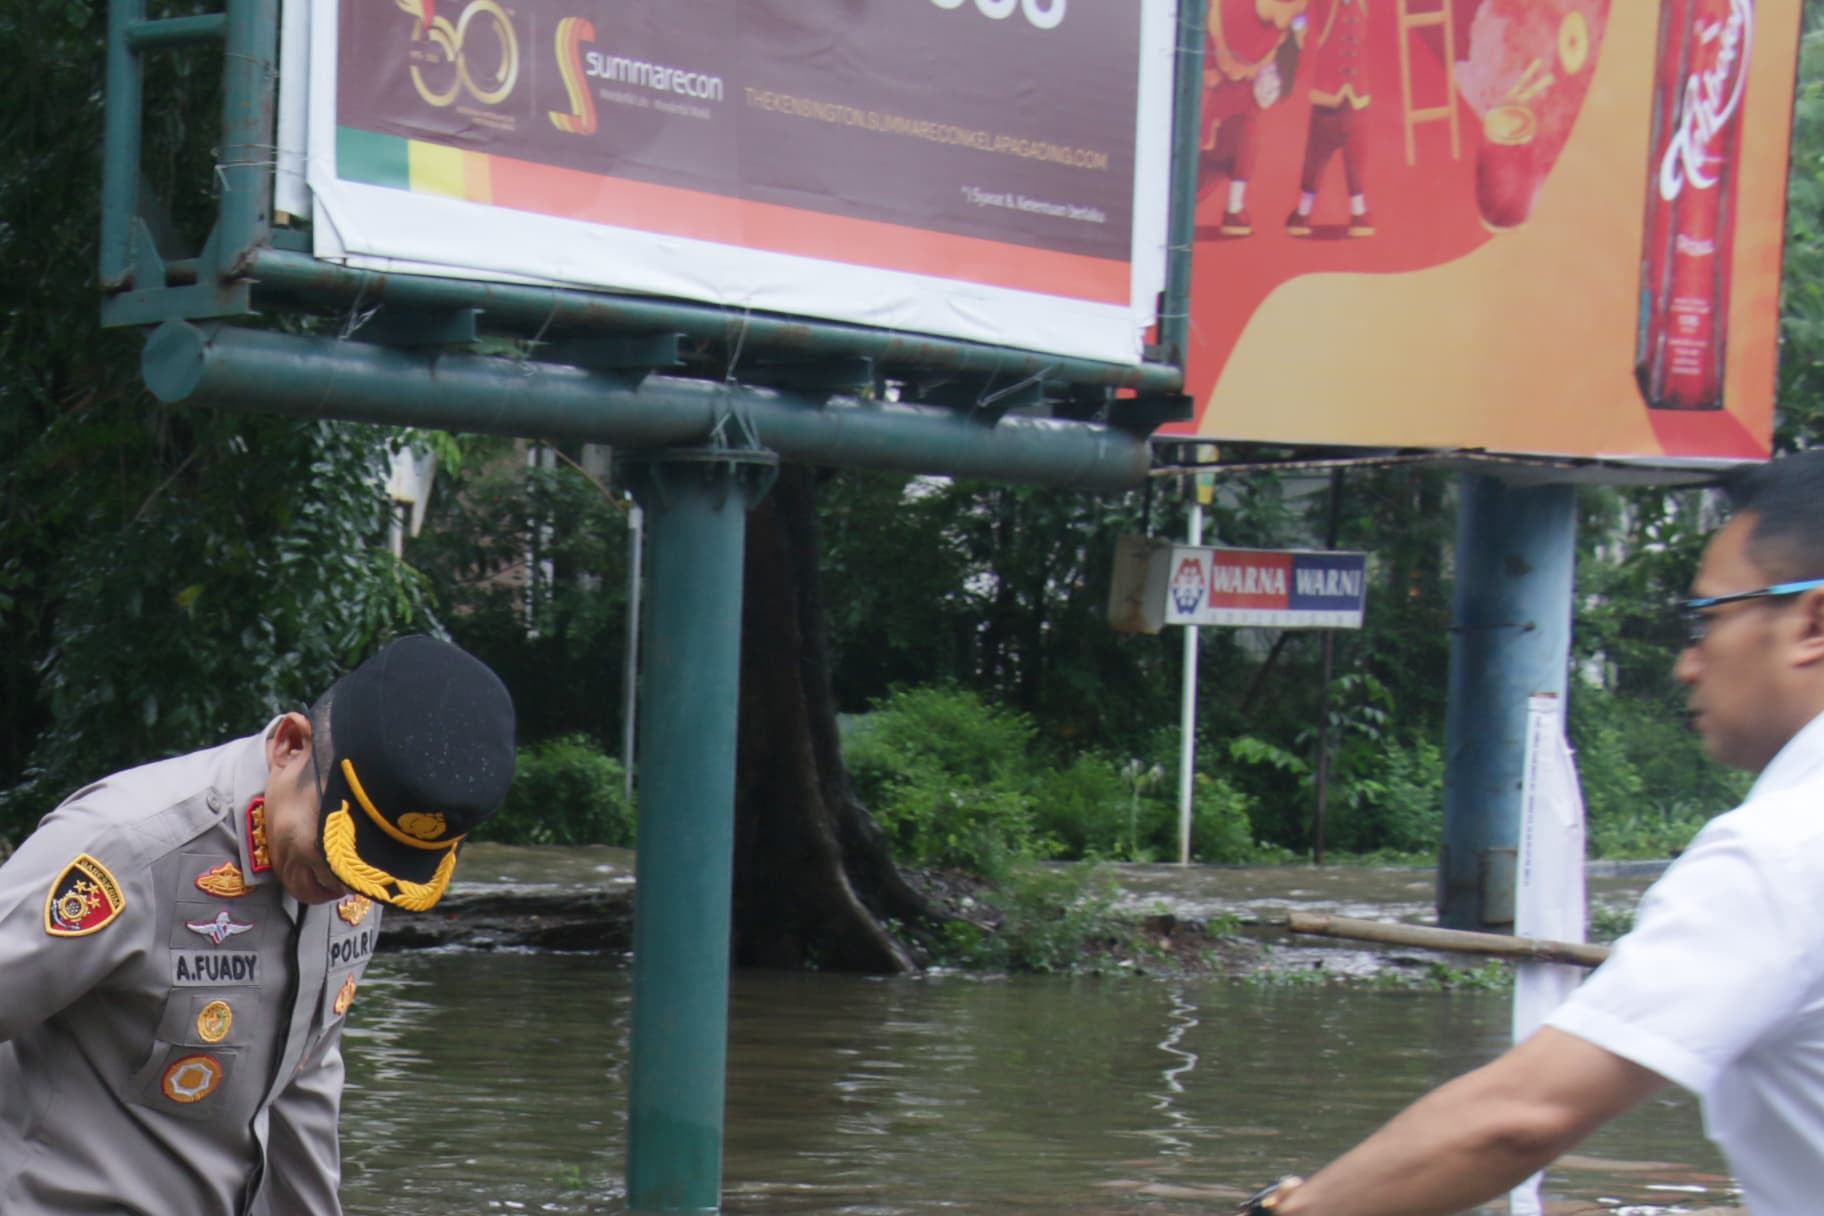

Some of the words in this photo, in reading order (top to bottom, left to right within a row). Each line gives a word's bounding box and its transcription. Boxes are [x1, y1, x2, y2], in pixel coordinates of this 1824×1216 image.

[586, 51, 723, 102] summarecon
[1213, 565, 1286, 595] WARNA
[1296, 568, 1362, 597] WARNI
[331, 929, 374, 968] POLRI
[177, 954, 257, 982] A.FUADY
